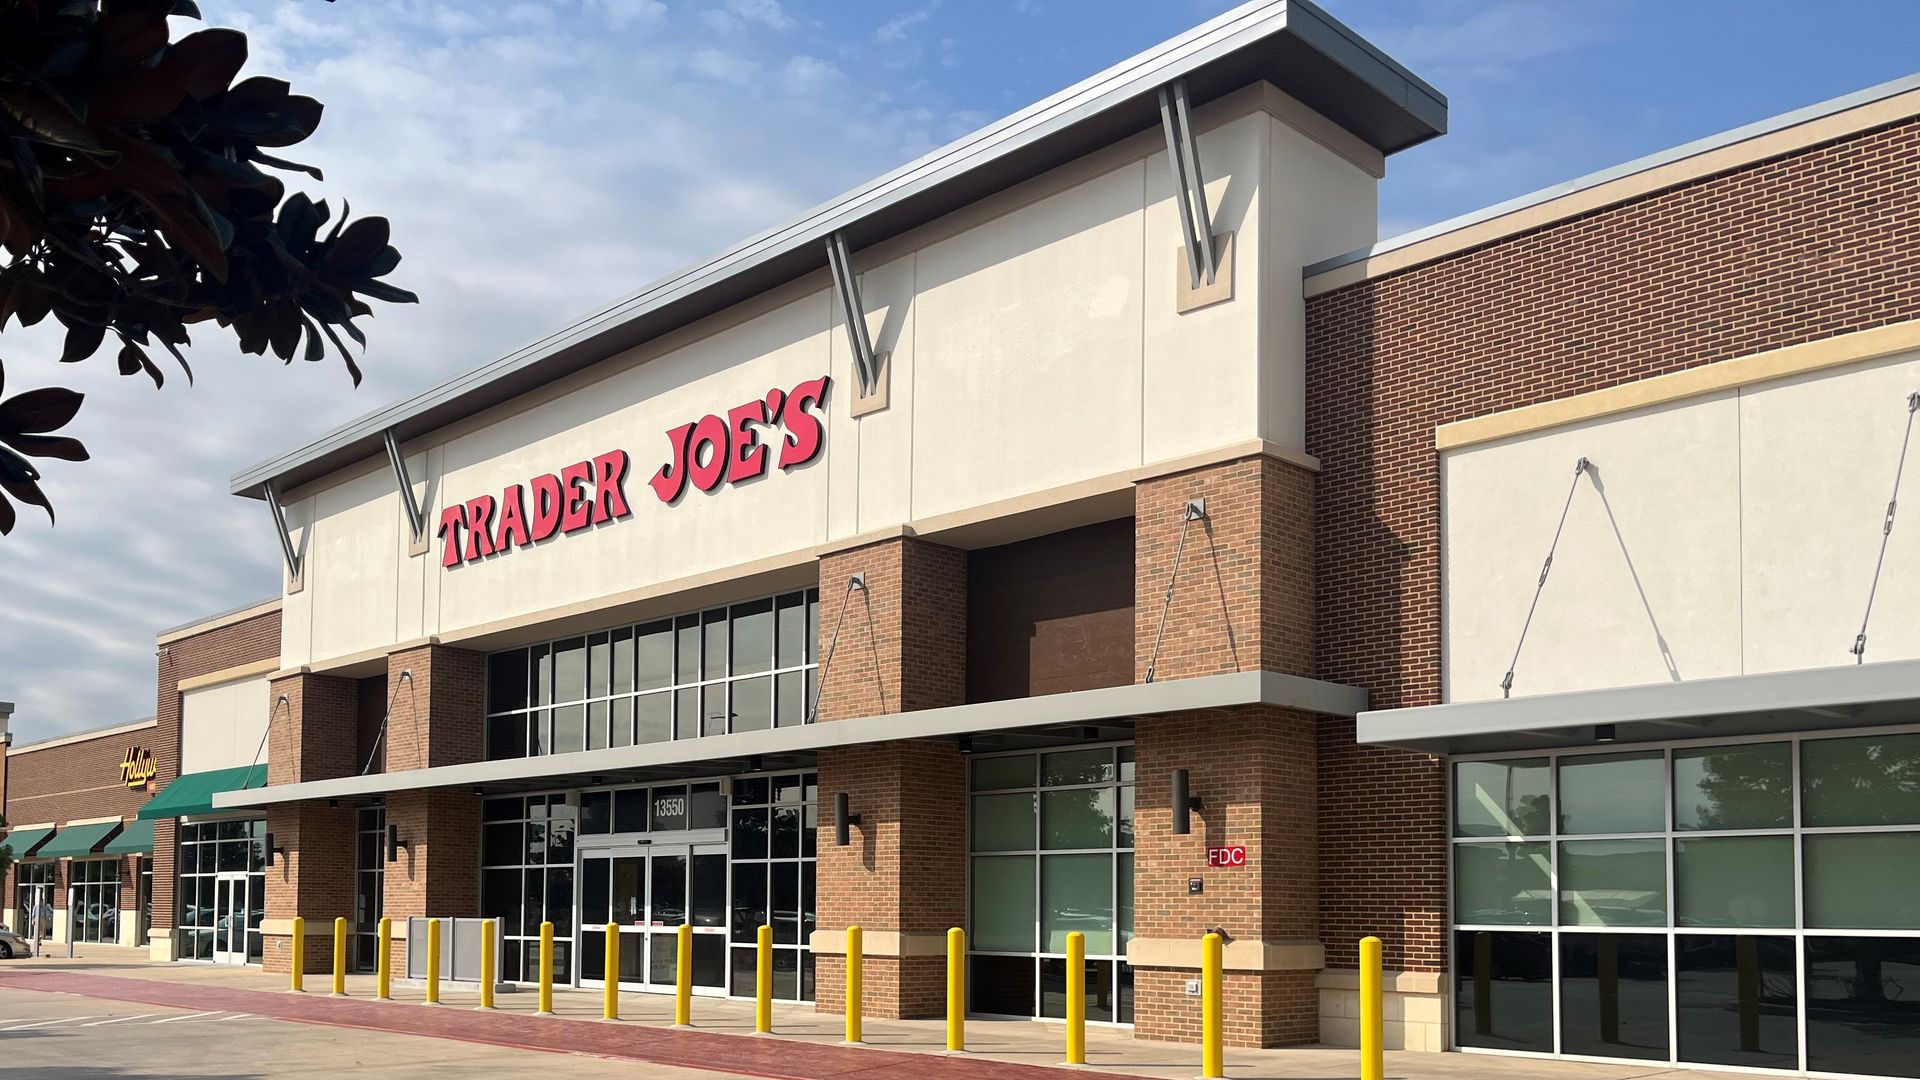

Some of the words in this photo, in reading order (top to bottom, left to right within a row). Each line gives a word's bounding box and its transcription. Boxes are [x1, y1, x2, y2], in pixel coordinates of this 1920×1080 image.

[438, 449, 631, 567] TRADER
[648, 376, 831, 504] JOE'S
[654, 798, 684, 817] 13550
[1208, 847, 1244, 865] FDC
